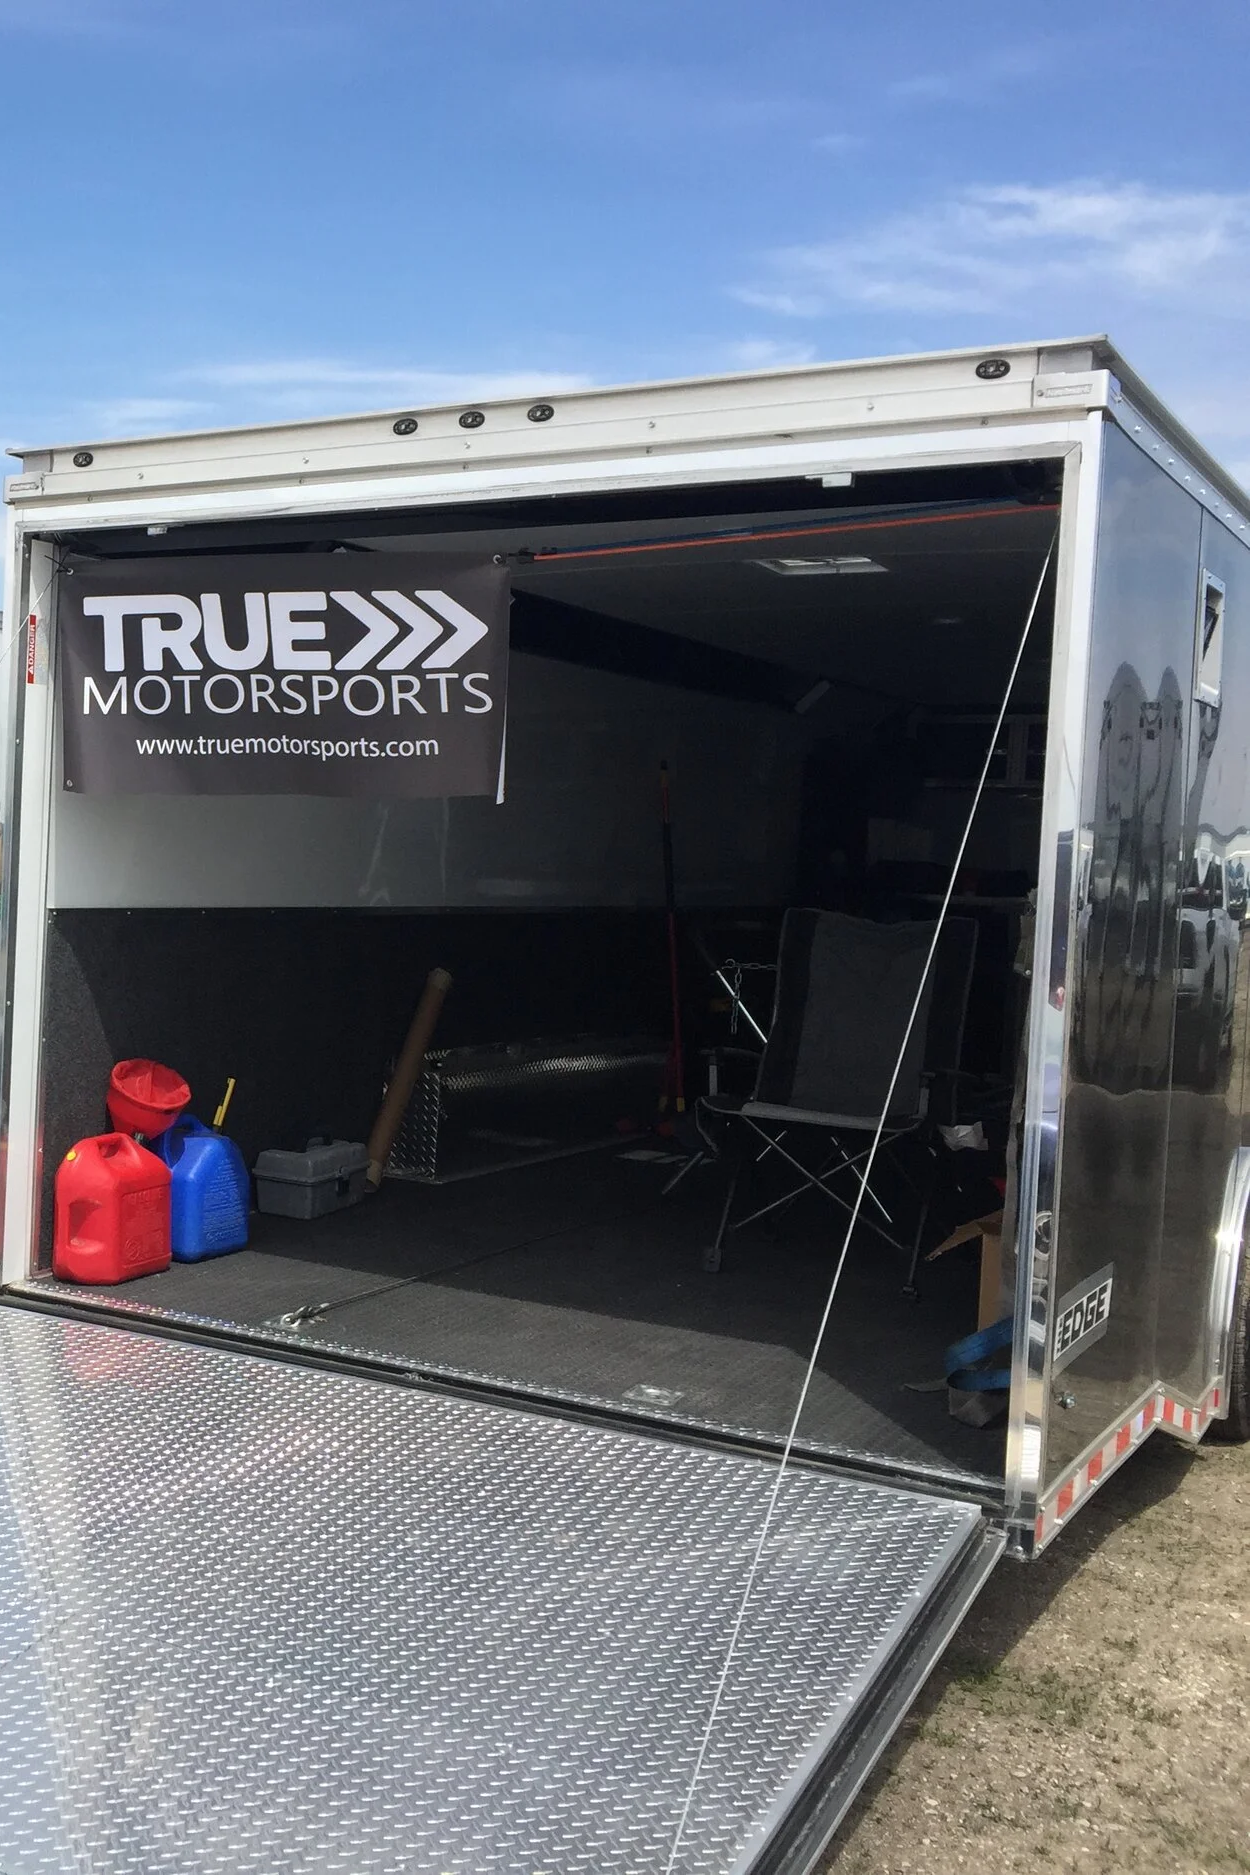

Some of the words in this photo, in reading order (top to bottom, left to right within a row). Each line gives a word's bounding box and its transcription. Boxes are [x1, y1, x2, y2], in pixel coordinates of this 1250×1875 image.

[83, 590, 332, 672] TRUE
[83, 672, 493, 717] MOTORSPORTS
[136, 735, 440, 761] www.truemotorsports.com
[1060, 1281, 1110, 1354] EDGE
